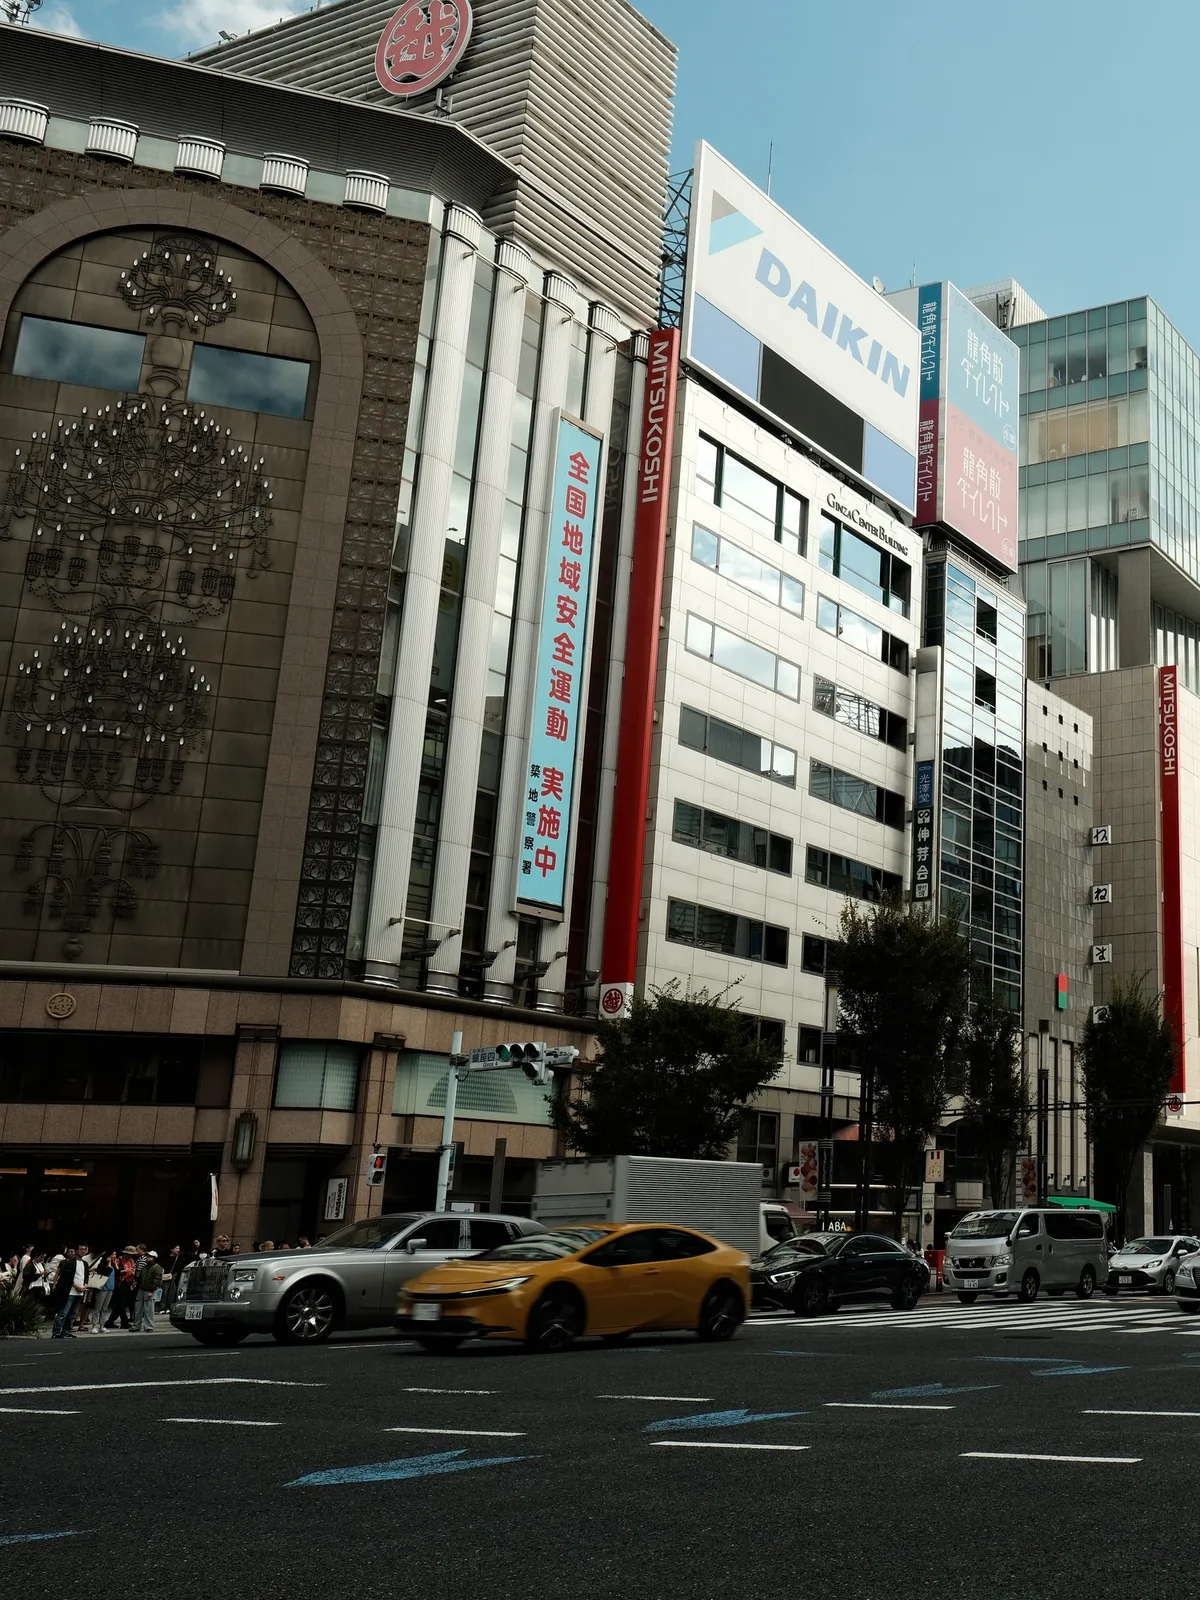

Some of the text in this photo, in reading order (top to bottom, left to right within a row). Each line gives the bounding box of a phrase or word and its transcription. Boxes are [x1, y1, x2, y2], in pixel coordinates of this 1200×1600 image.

[754, 247, 911, 399] DAIKIN
[921, 301, 937, 381] 龍角散ダイレクト
[967, 328, 1004, 386] 龍角散
[642, 340, 669, 504] MITSUKOSHI
[961, 358, 1009, 418] ダイレクト
[918, 419, 935, 502] 龍角散ダイレクト
[963, 446, 1001, 501] 龍角散
[957, 477, 1008, 534] ダイレクト
[534, 451, 591, 878] 全国地域安全運動 実施中
[1162, 672, 1176, 777] MITSUKOSHI
[521, 763, 541, 875] 築地警察署
[915, 826, 931, 881] 伸芽会
